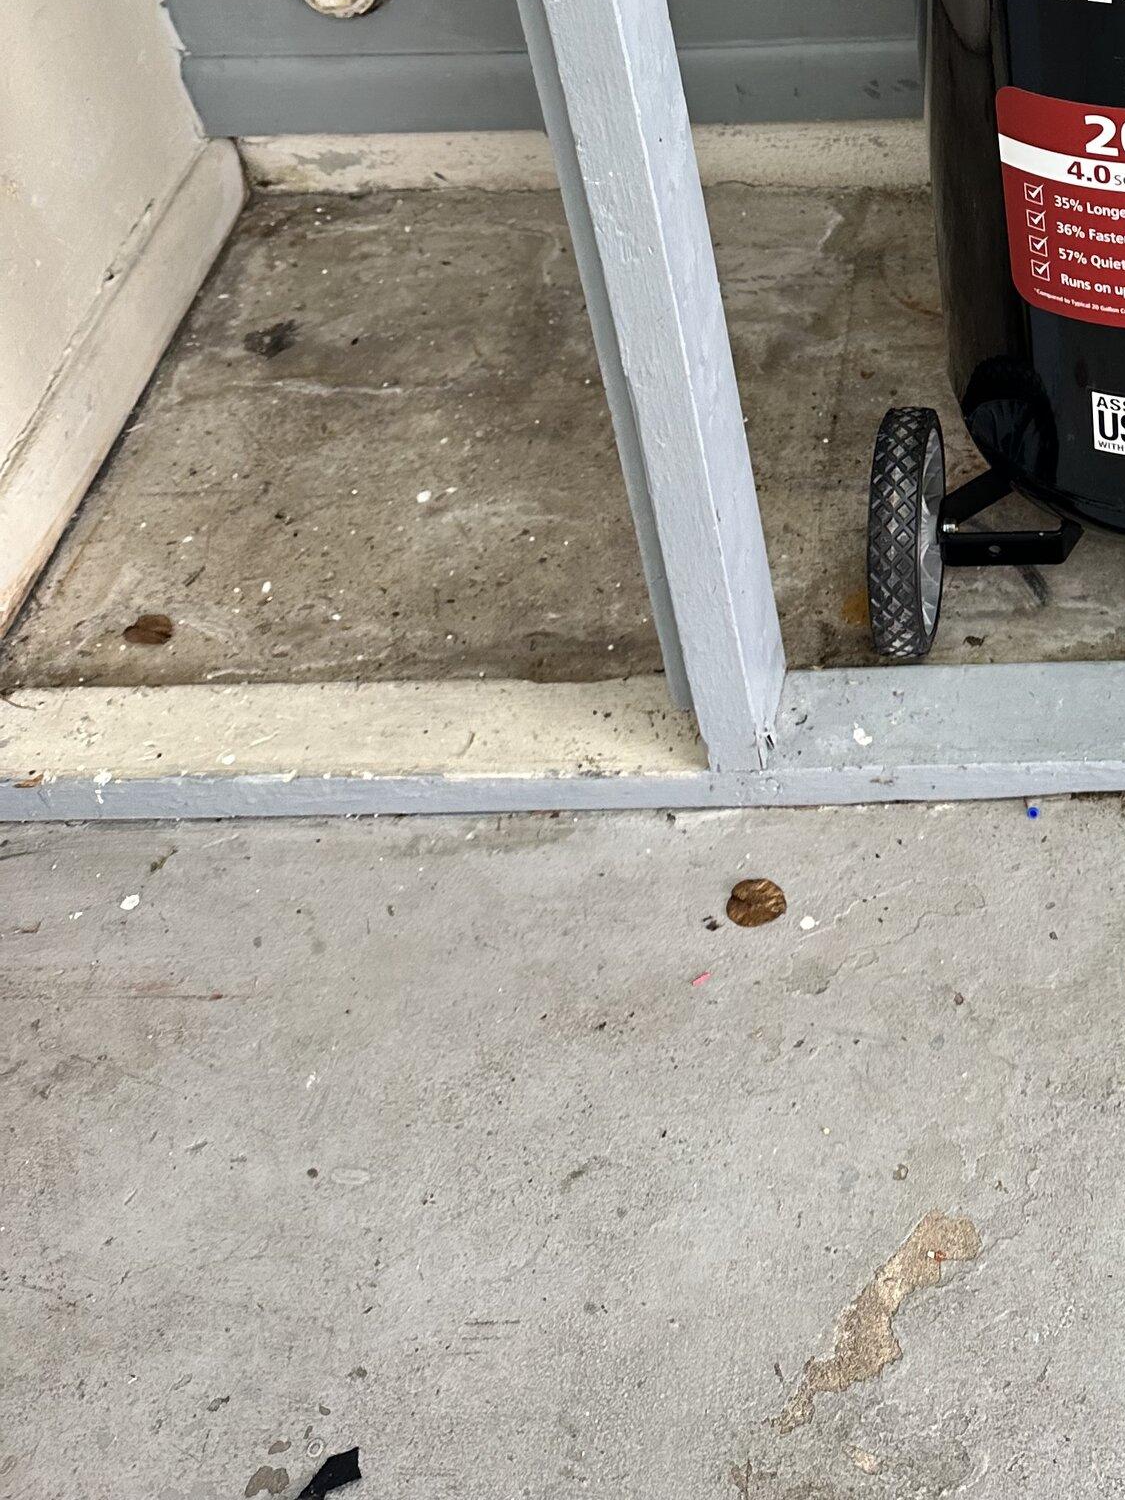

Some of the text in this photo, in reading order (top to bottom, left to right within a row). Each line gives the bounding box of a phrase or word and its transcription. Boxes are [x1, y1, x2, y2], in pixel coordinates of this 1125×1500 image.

[1067, 161, 1111, 184] 4.0
[1054, 195, 1083, 212] 35%
[1056, 221, 1085, 239] 36%
[1058, 248, 1087, 265] 57%
[1060, 273, 1091, 291] Runs
[1094, 282, 1112, 295] on
[1098, 440, 1124, 451] WITH
